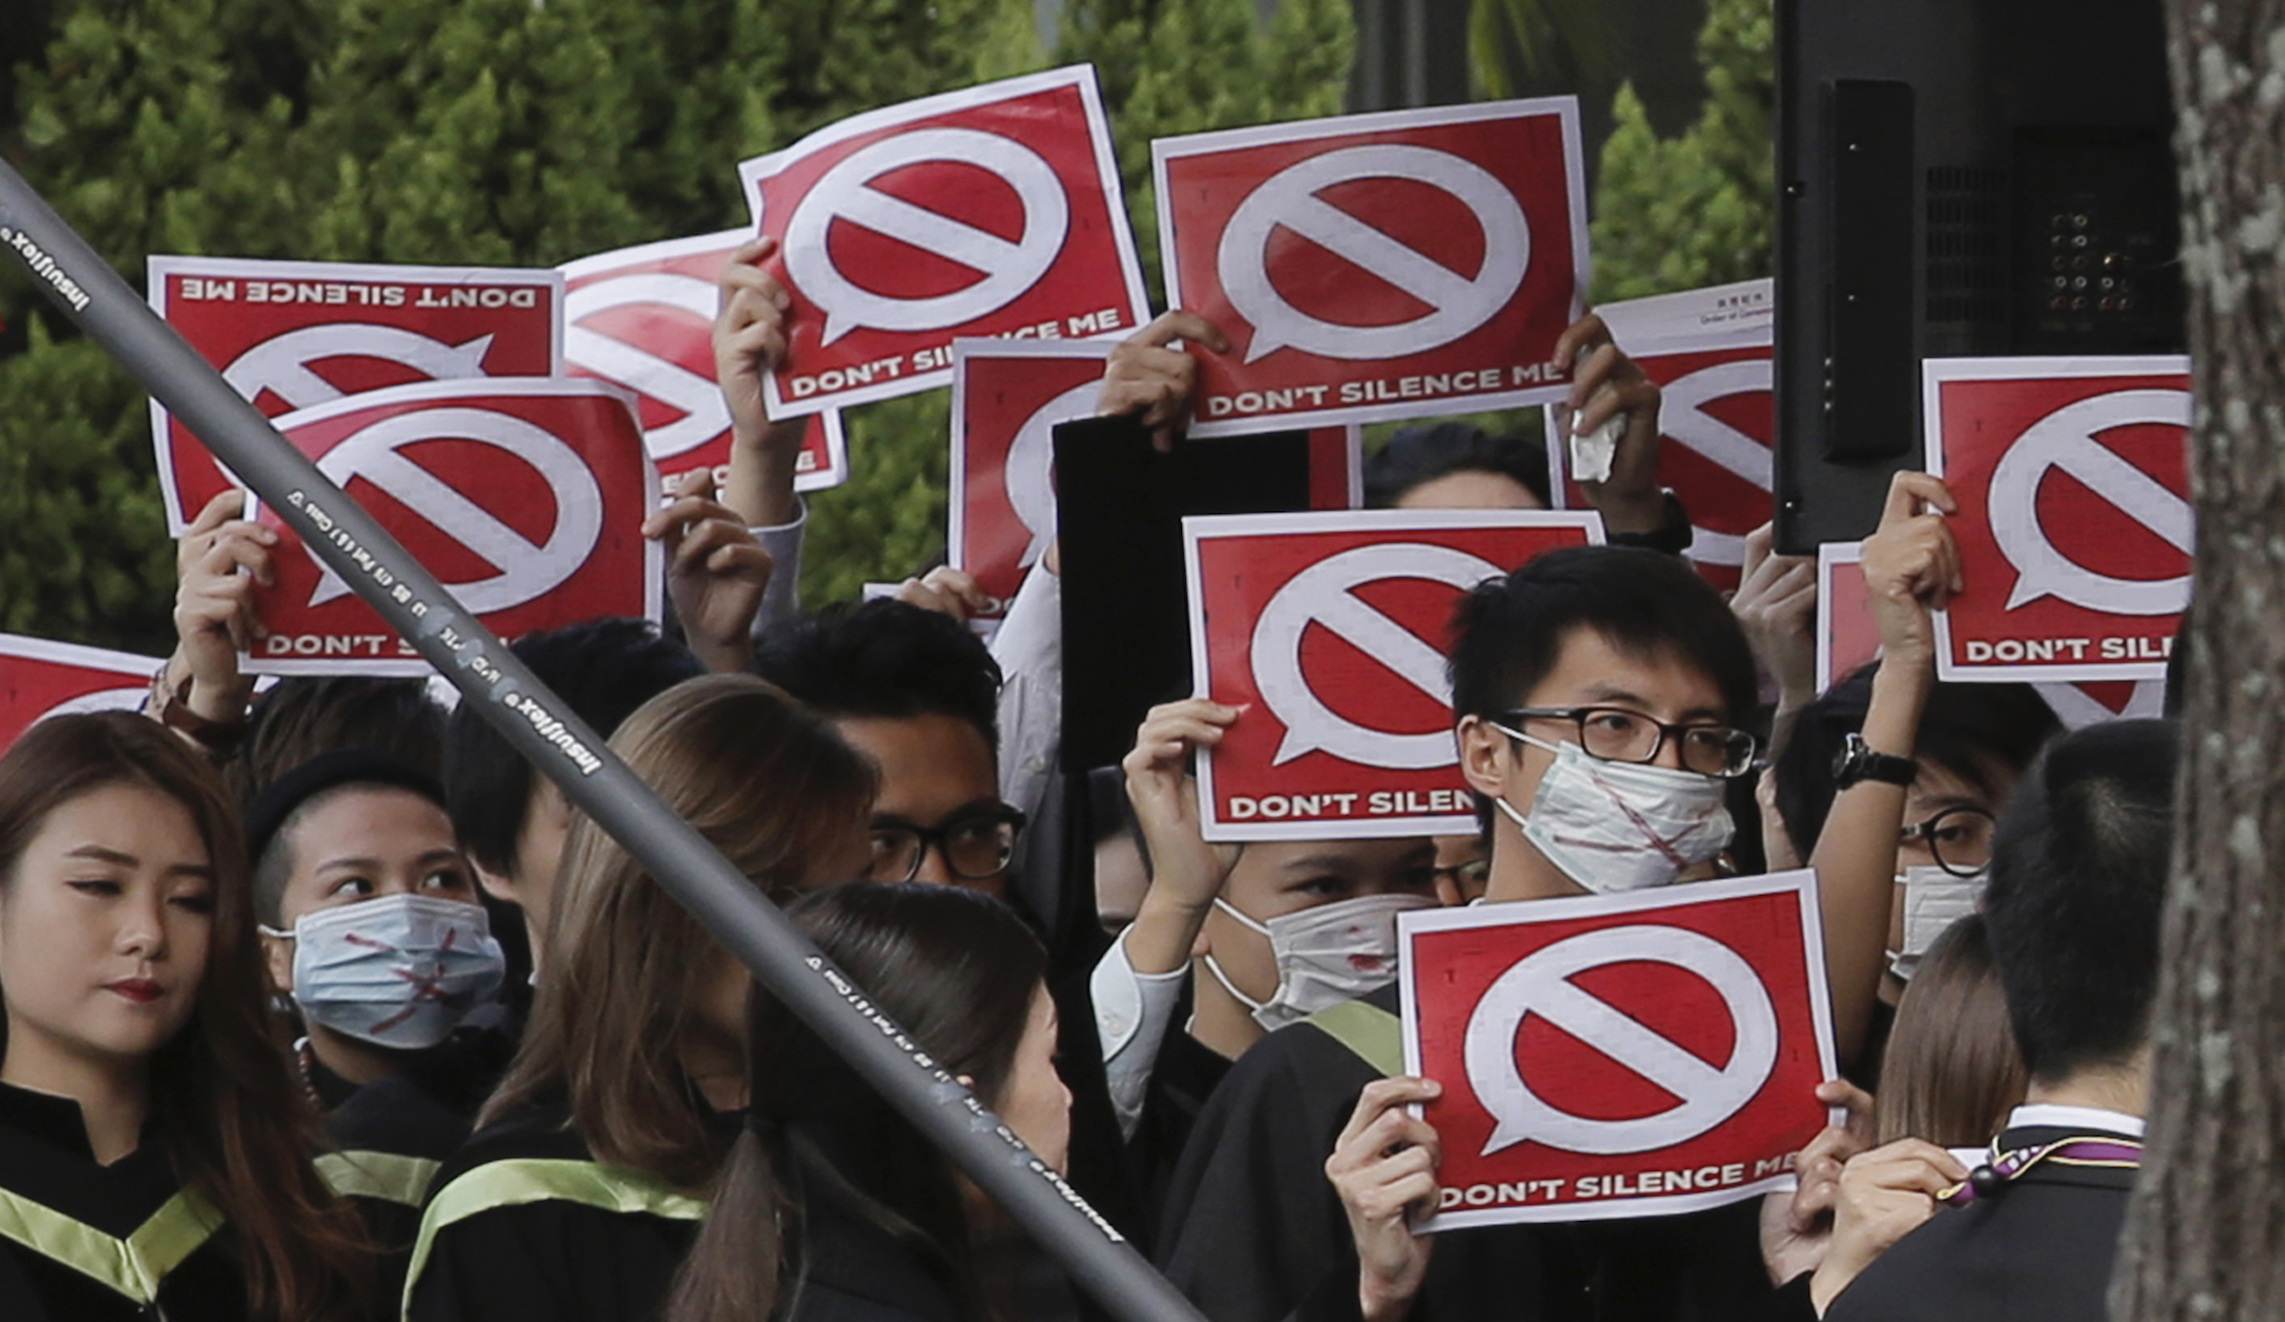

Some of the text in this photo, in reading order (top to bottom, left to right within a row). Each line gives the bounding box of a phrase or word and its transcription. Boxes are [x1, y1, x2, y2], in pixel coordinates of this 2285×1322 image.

[181, 278, 536, 308] DON'T SILENCE ME
[790, 356, 904, 398] DON'T
[1068, 308, 1121, 336] ME
[1208, 360, 1564, 416] DON'T SILENCE ME
[266, 635, 388, 655] DON'T
[1966, 638, 2091, 661] DON'T
[1229, 793, 1358, 818] DON'T
[1438, 1178, 1565, 1209] DON'T
[1575, 1162, 1745, 1198] SILENCE
